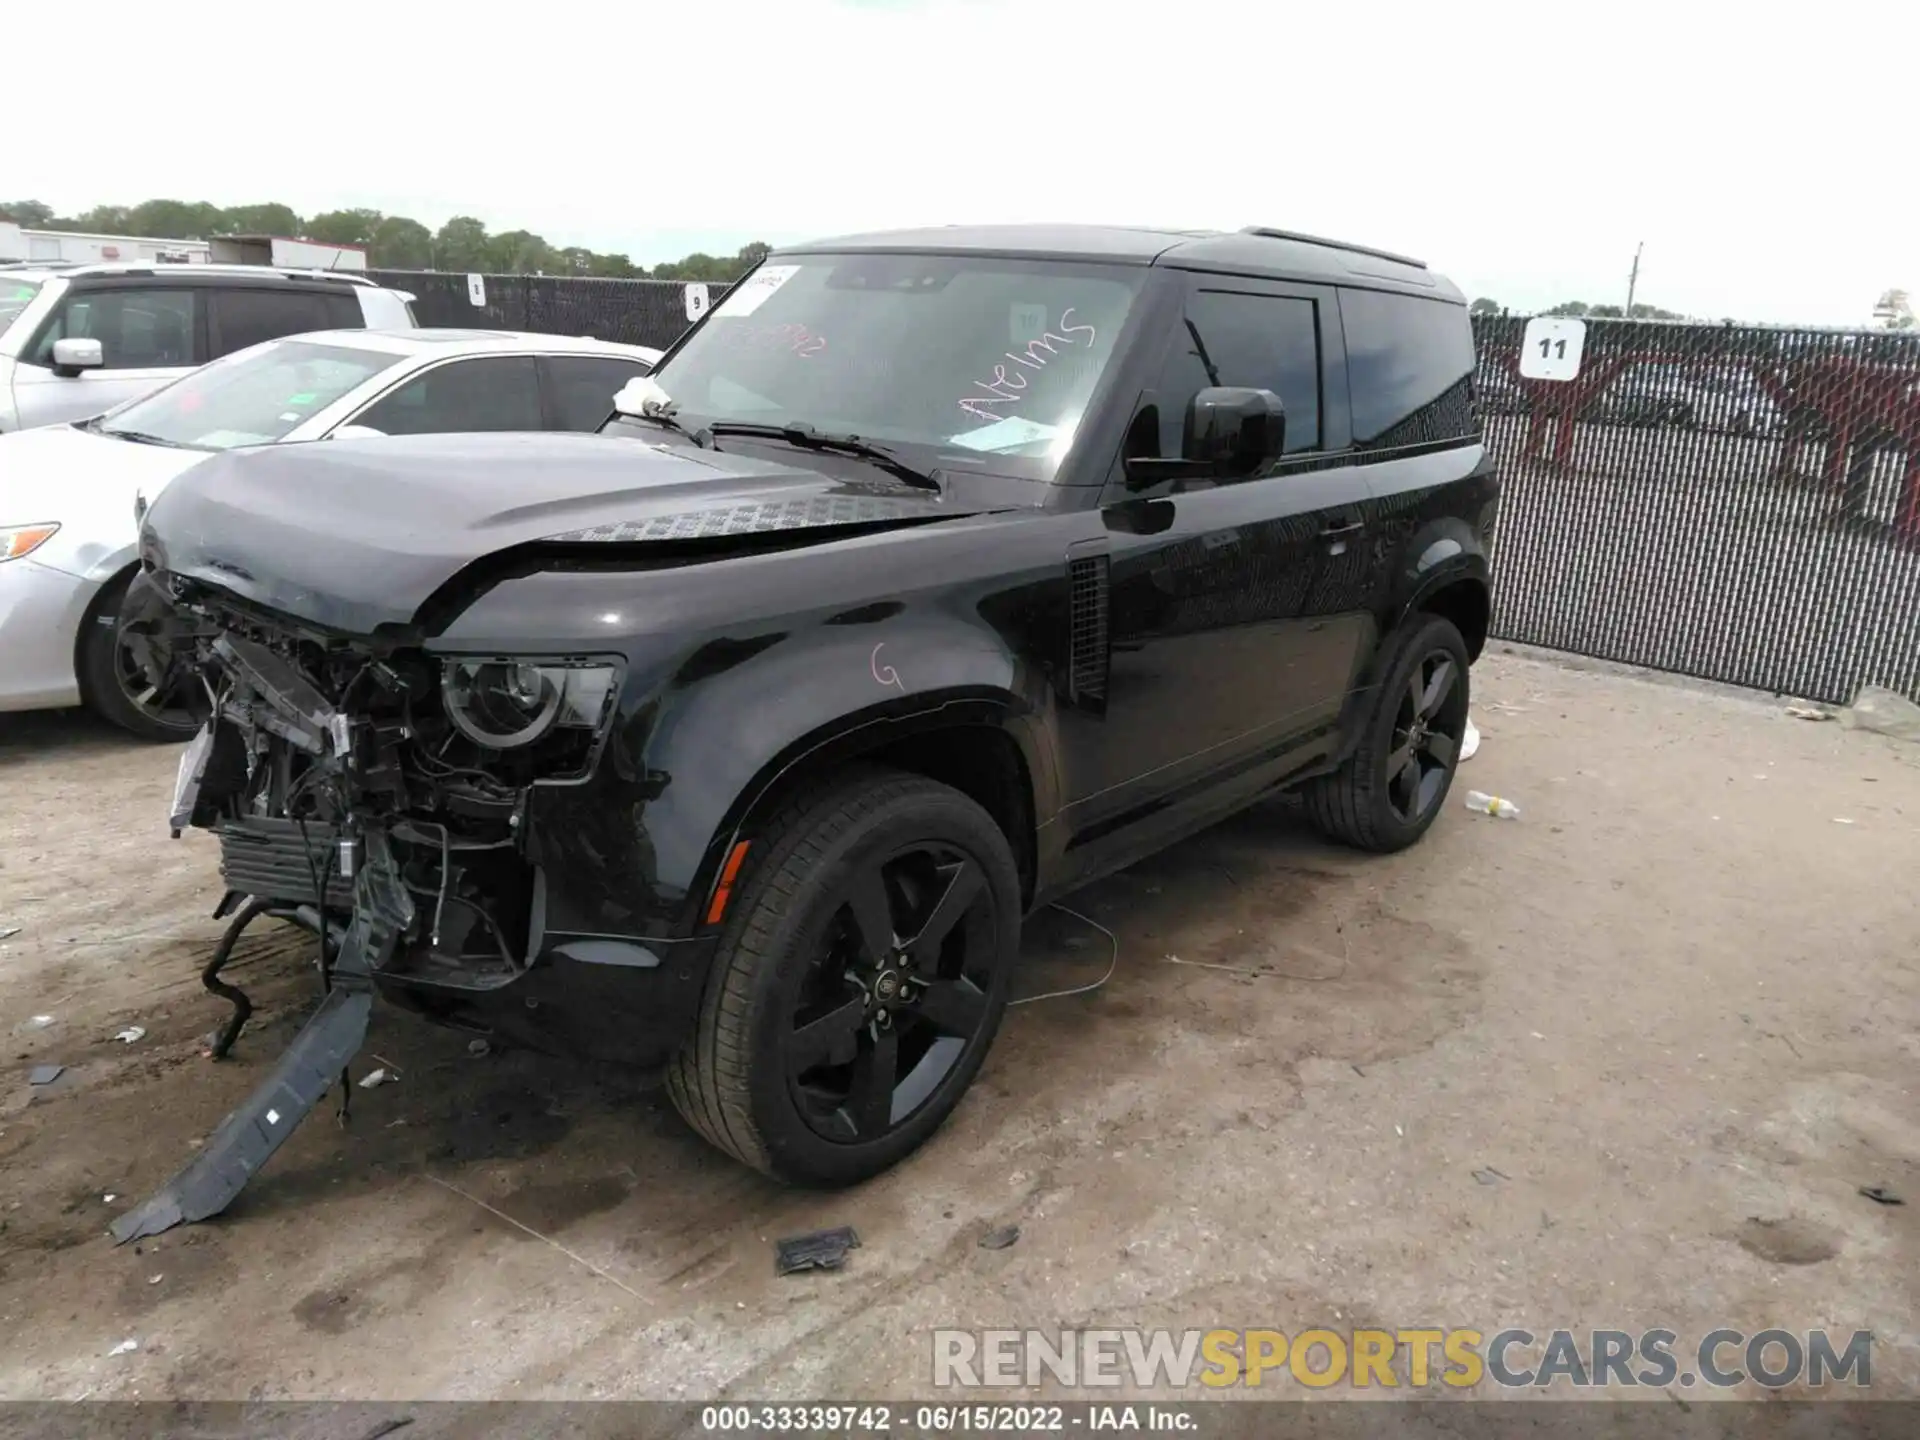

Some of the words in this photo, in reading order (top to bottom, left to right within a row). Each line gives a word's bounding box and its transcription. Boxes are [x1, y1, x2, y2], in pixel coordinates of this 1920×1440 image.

[693, 296, 701, 310] 9
[1538, 337, 1567, 360] 11
[958, 307, 1096, 422] Nelms
